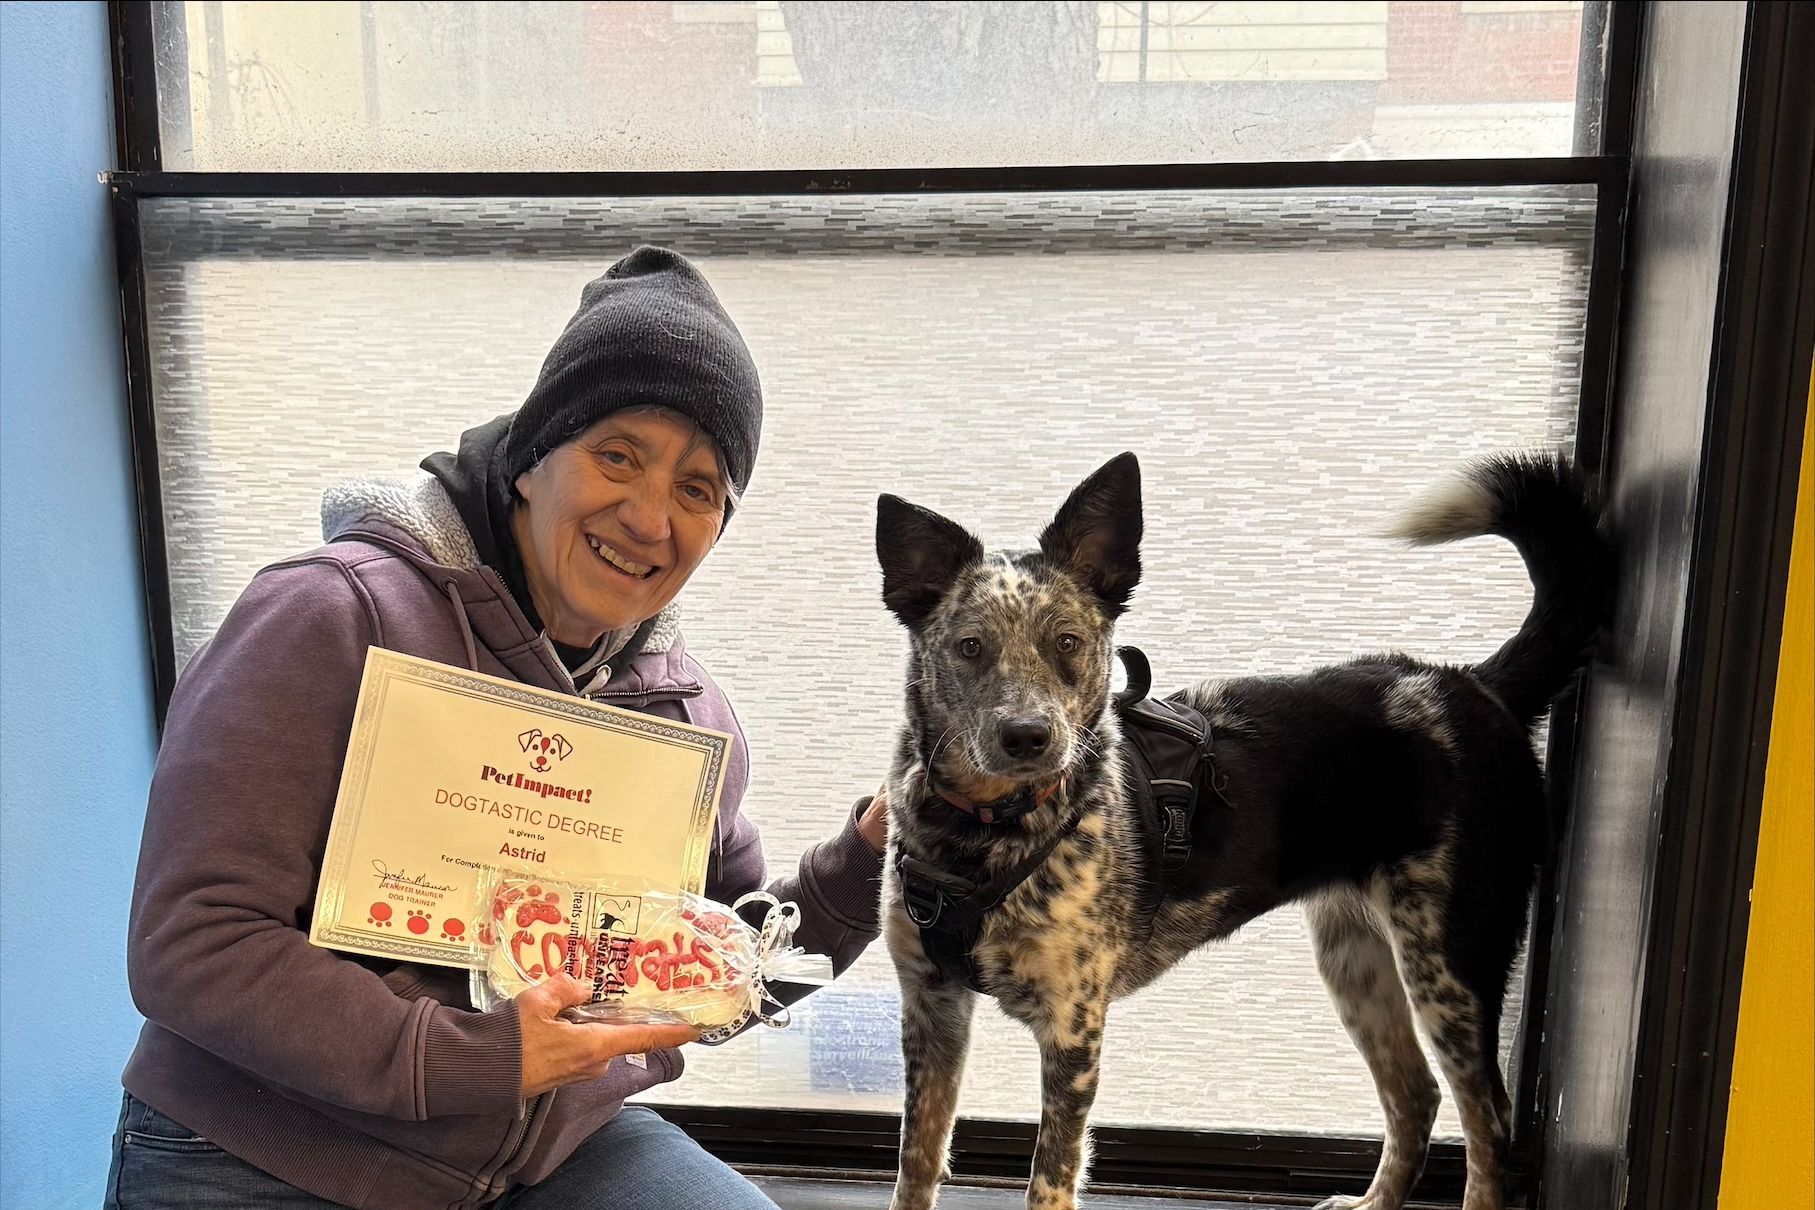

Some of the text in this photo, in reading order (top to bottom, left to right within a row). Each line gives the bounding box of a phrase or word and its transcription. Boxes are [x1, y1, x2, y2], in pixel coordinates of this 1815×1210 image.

[481, 765, 593, 804] PetImpact!
[435, 789, 624, 844] DOGTASTIC DEGREE
[516, 829, 536, 841] given
[441, 854, 454, 863] For
[499, 842, 547, 863] Astrid
[388, 892, 436, 907] DOG TRAINER
[415, 888, 444, 900] MAURER
[592, 932, 609, 1003] UNLEASHE
[604, 936, 636, 1001] treat
